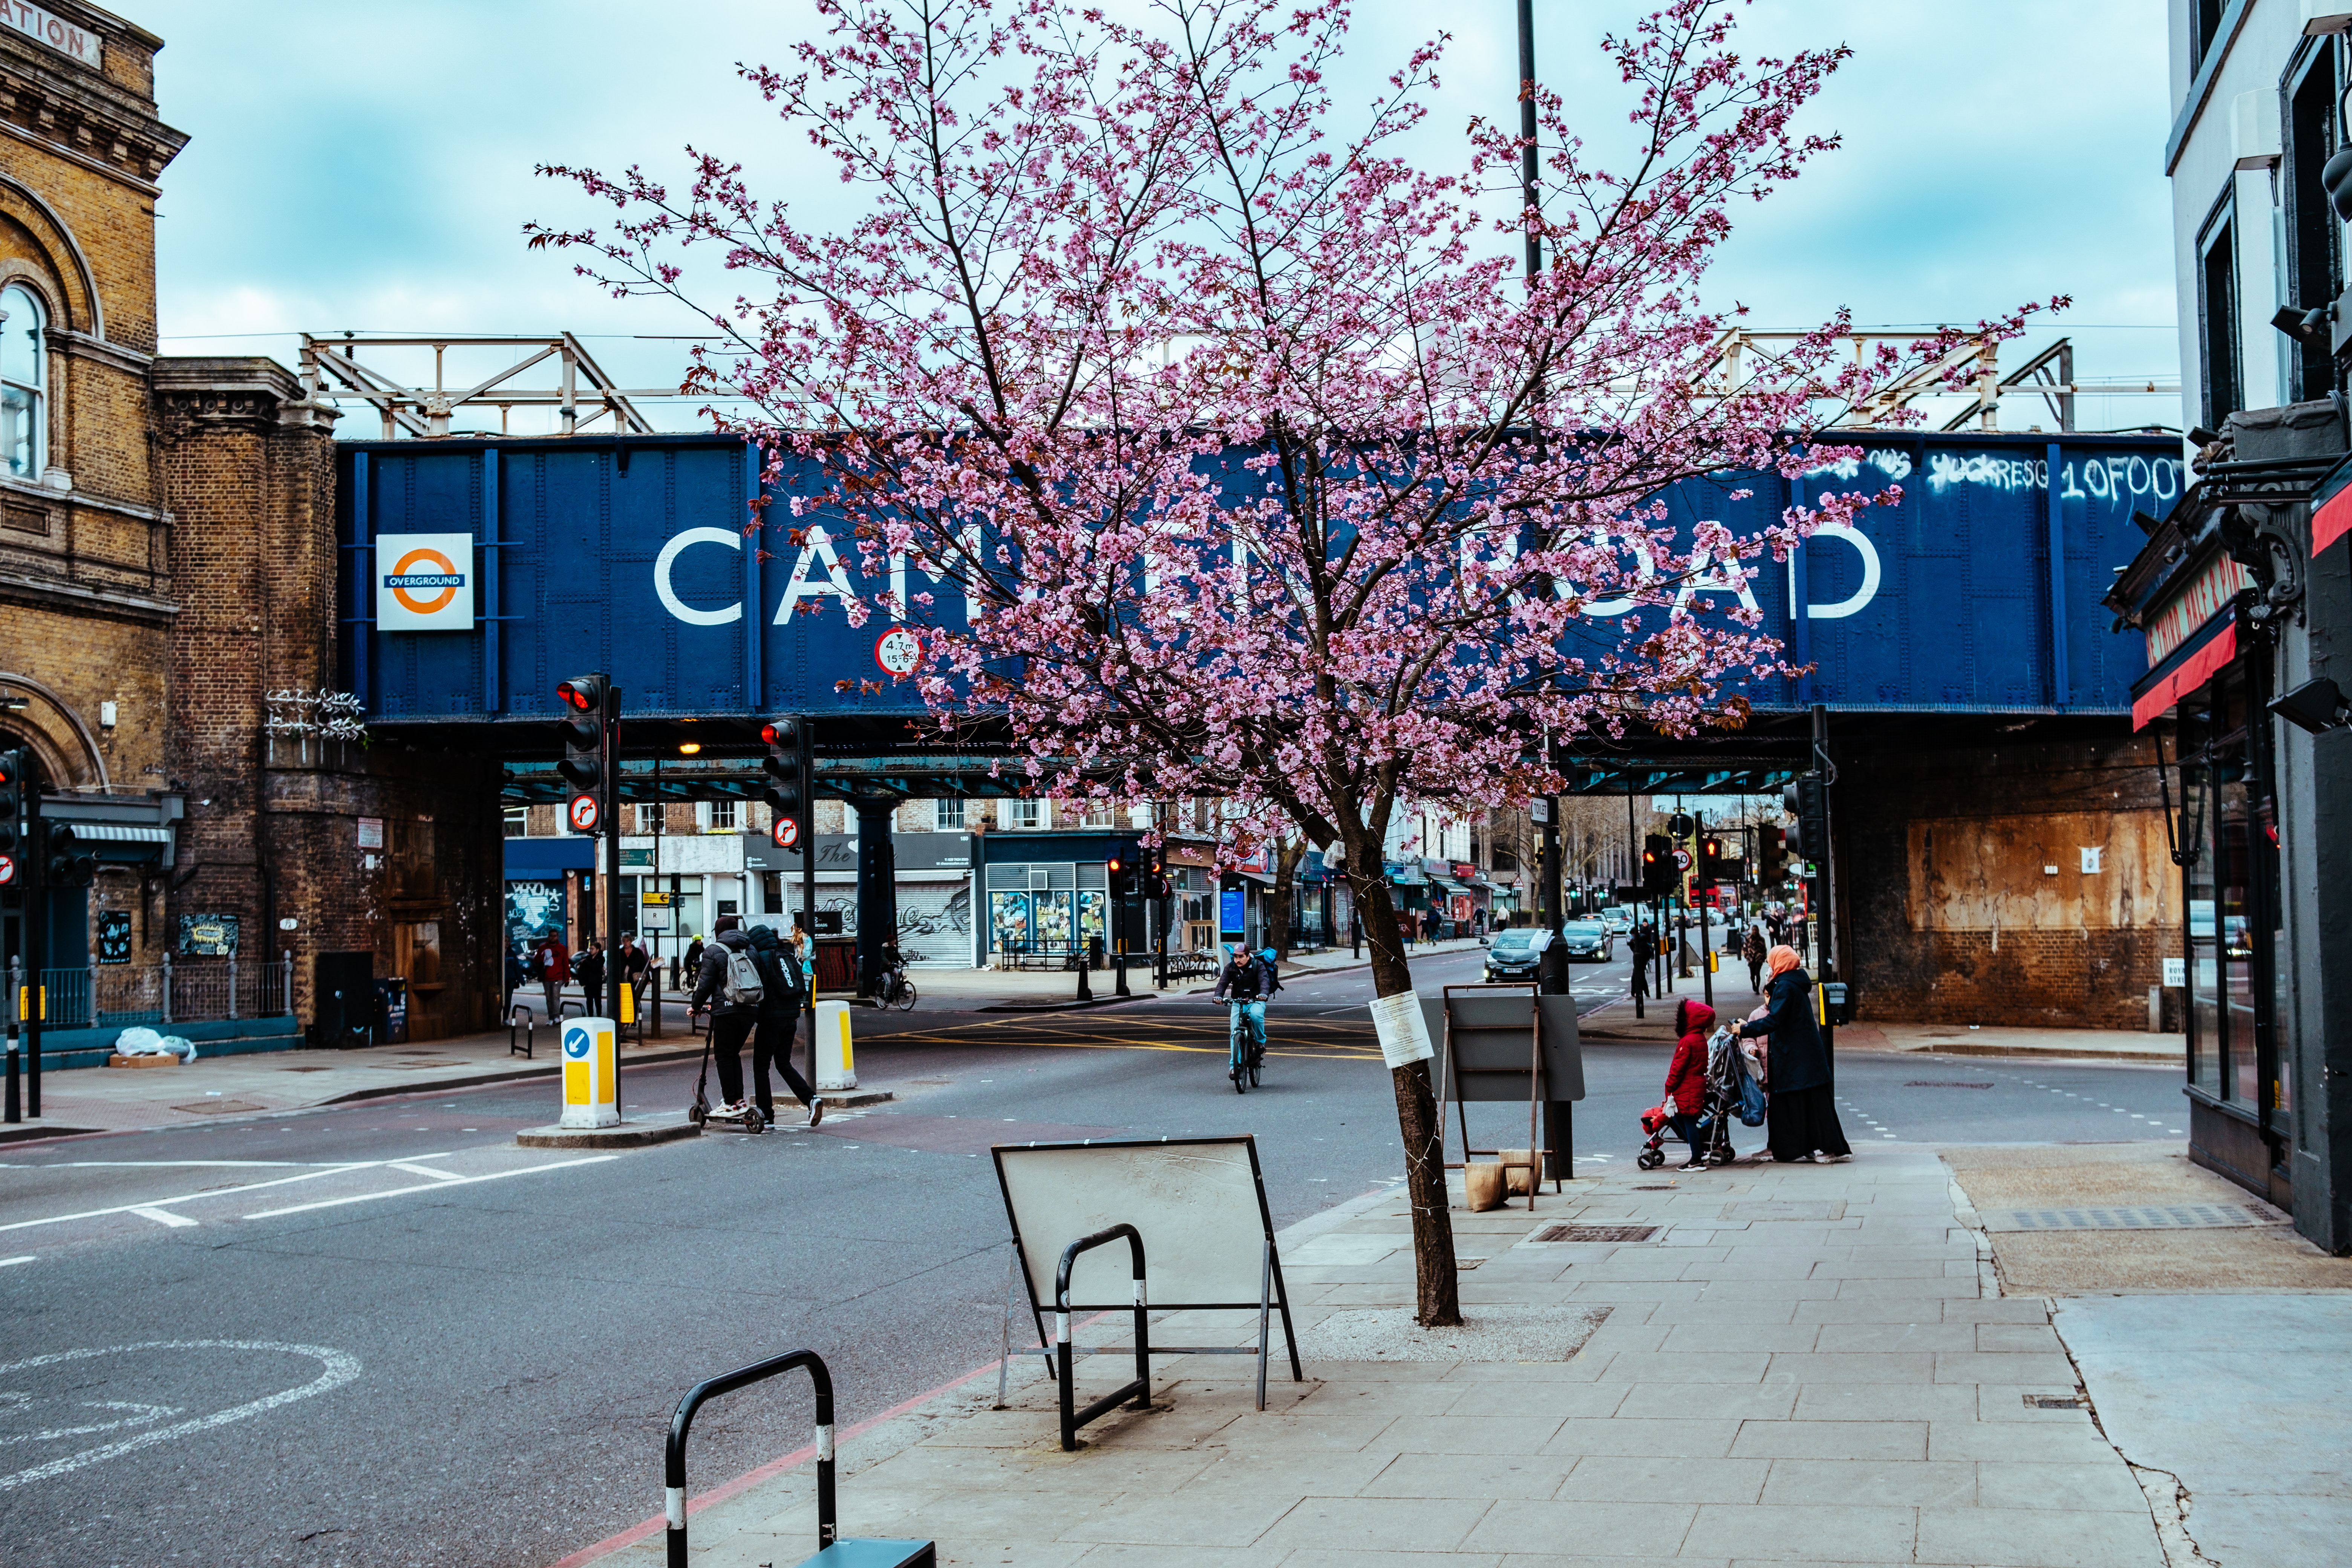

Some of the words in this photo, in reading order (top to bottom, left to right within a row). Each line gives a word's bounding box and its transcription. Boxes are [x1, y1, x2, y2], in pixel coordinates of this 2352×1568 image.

[389, 576, 459, 586] OVERGROUND
[654, 523, 1325, 626] CAMEN
[2184, 575, 2208, 634] HALF
[1534, 803, 1547, 815] TOILET
[815, 842, 851, 862] The
[1678, 855, 1687, 864] 0
[779, 958, 793, 988] adidas
